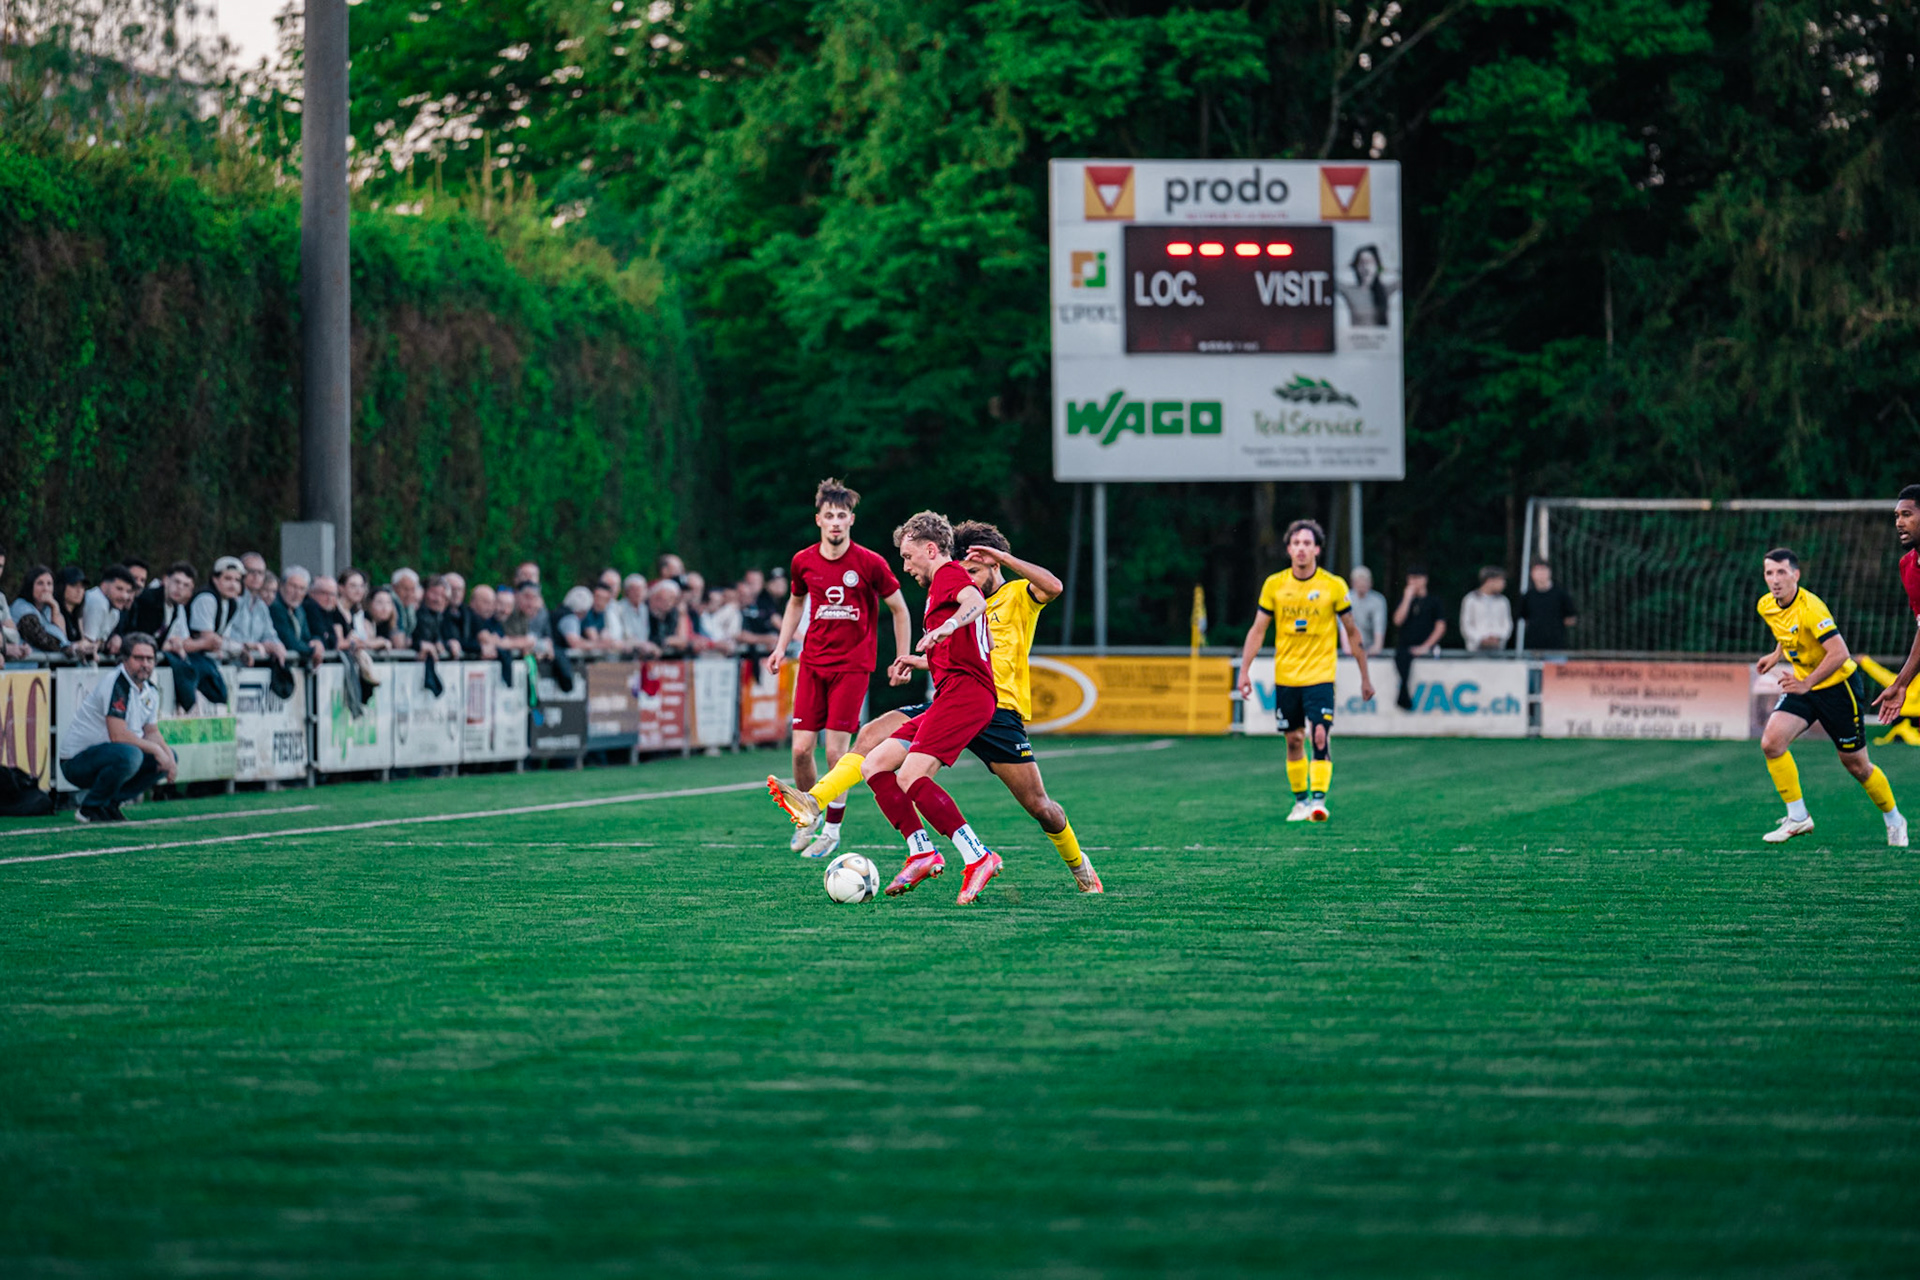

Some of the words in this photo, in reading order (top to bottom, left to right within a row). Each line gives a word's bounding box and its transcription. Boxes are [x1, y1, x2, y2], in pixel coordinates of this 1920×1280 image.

[1165, 167, 1289, 214] prodo
[1133, 270, 1204, 306] LOC.
[1255, 270, 1332, 306] VISIT.
[1066, 390, 1223, 446] WAGO
